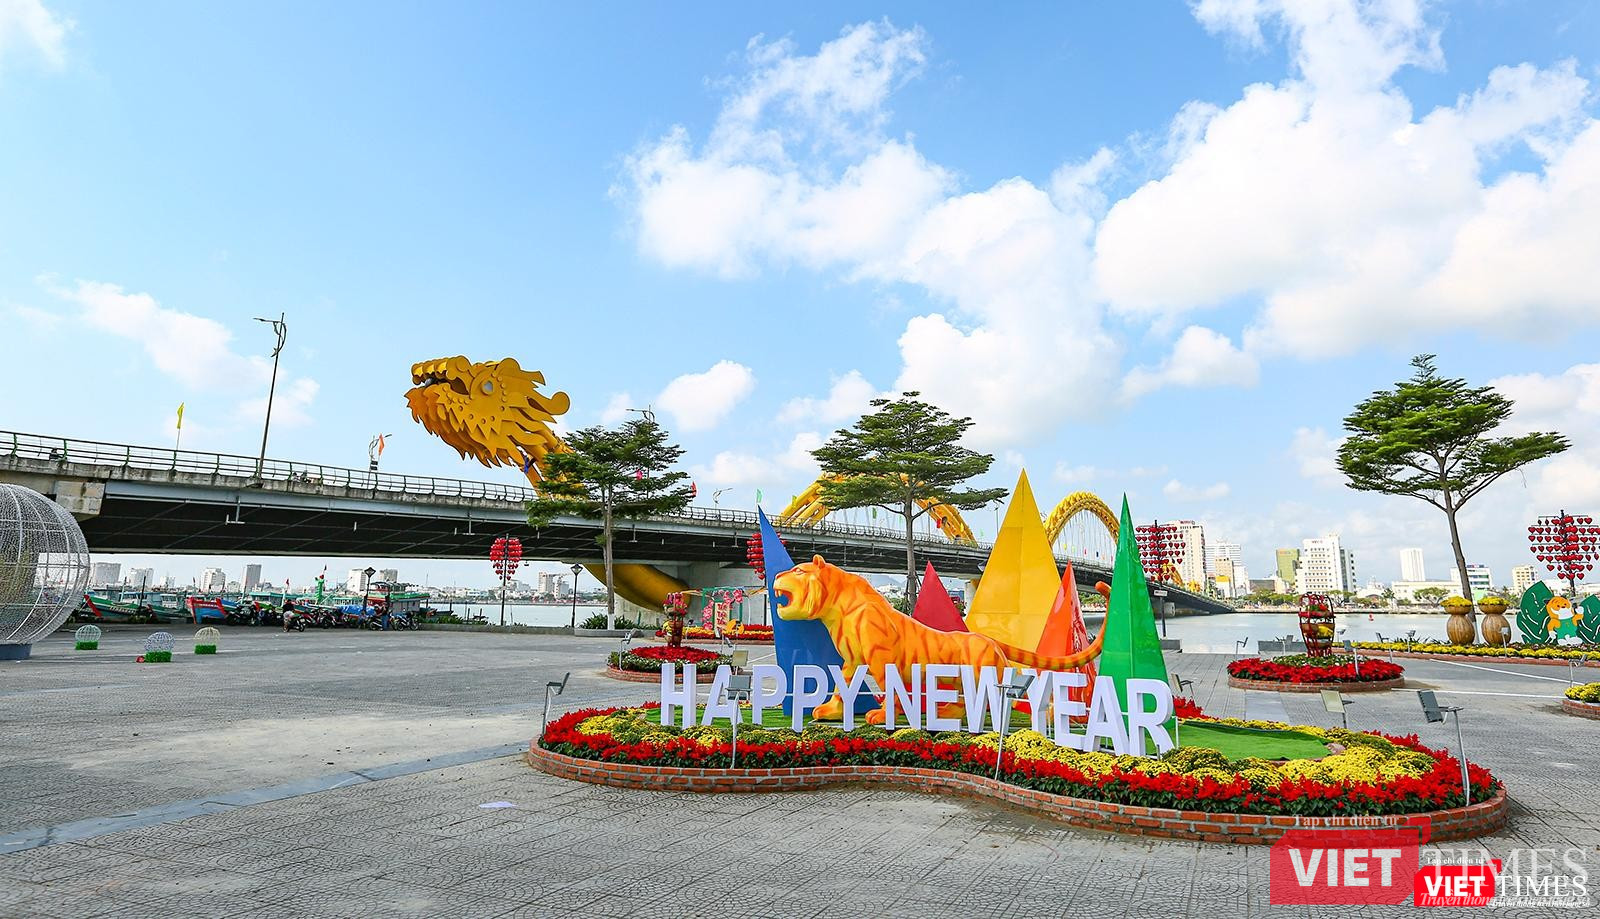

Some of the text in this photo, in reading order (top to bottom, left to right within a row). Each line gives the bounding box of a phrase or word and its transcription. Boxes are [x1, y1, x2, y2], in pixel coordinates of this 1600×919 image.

[661, 663, 1175, 757] HAPPY NEW YEAR
